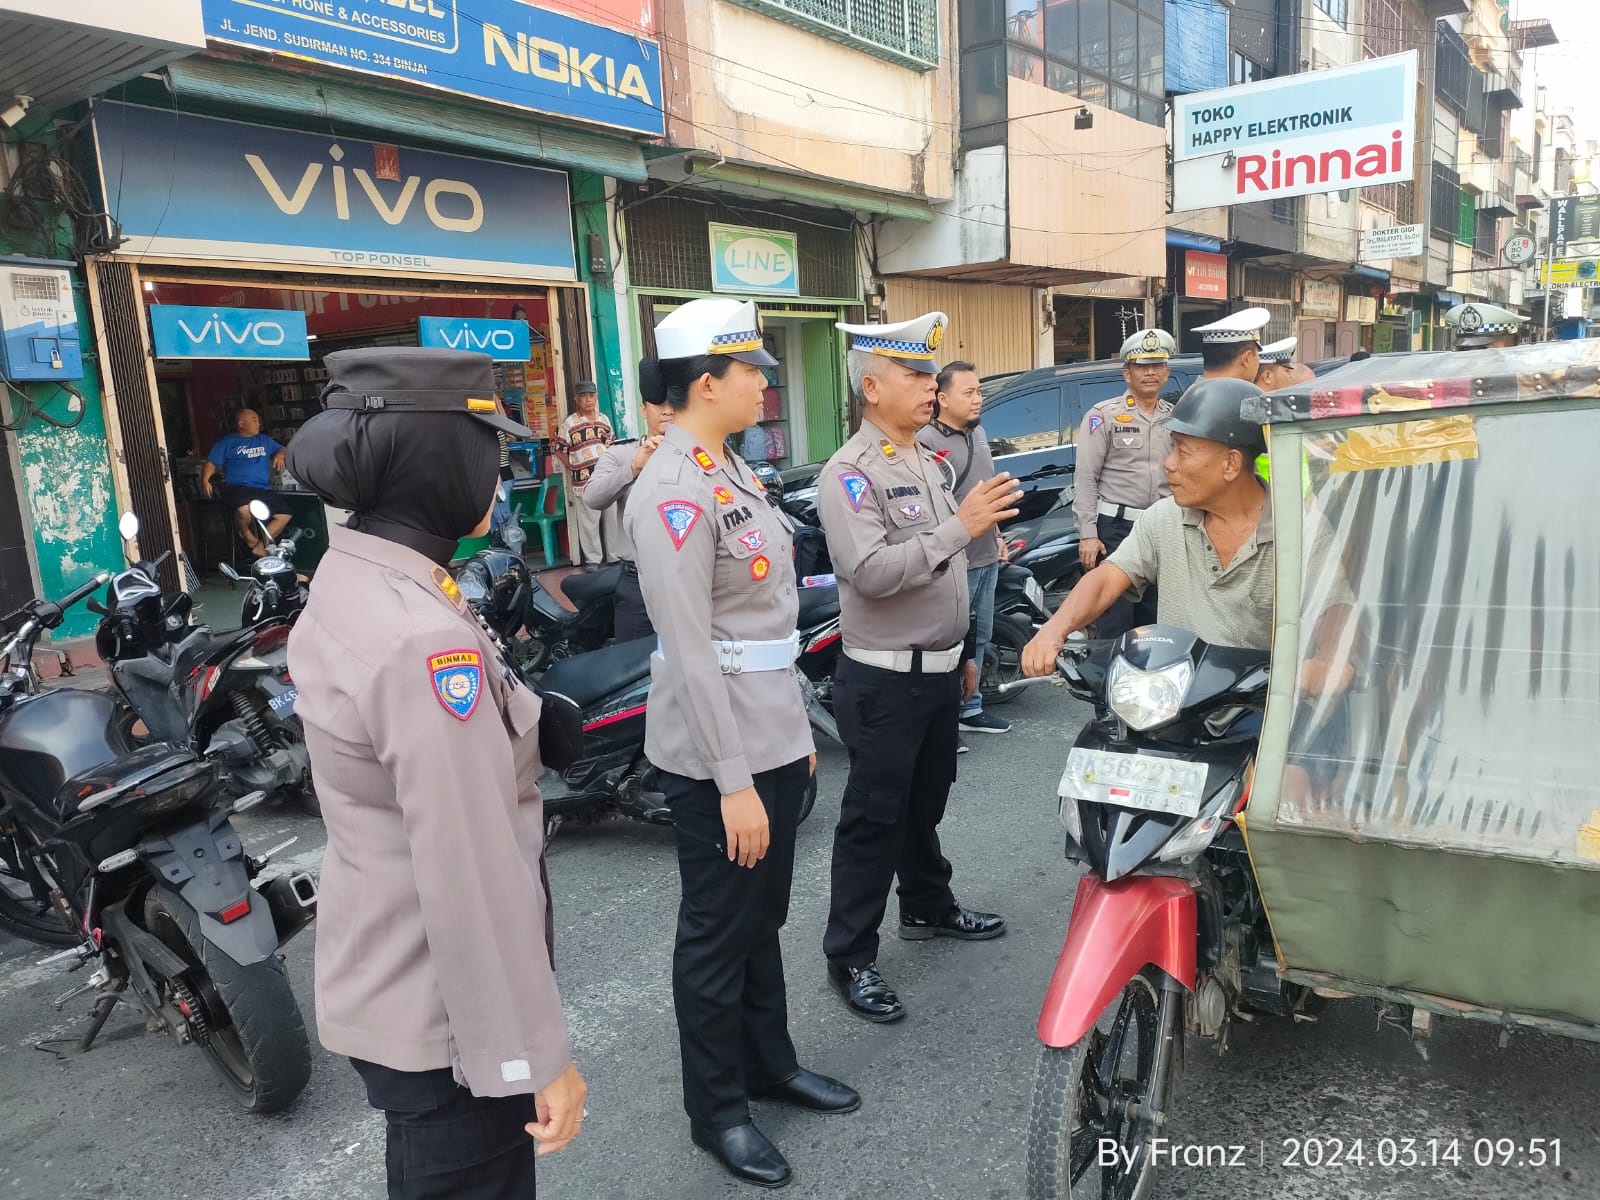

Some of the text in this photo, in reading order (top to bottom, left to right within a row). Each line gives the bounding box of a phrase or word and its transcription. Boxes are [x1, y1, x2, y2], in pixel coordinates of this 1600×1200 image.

[338, 6, 349, 20] &
[351, 10, 446, 44] ACCESSORIES
[220, 18, 428, 75] JL. JEND. SUDIRMAN NO. 334 BINJAI
[482, 22, 654, 106] NOKIA
[1192, 105, 1235, 125] TOKO
[1192, 106, 1353, 147] HAPPY ELEKTRONIK
[1236, 129, 1403, 194] Rinnai
[244, 143, 484, 233] vivo
[330, 250, 431, 267] TOP PONSEL
[731, 248, 787, 273] LINE
[178, 312, 284, 346] vivo
[440, 322, 515, 350] vivo
[436, 654, 472, 666] BINMAS
